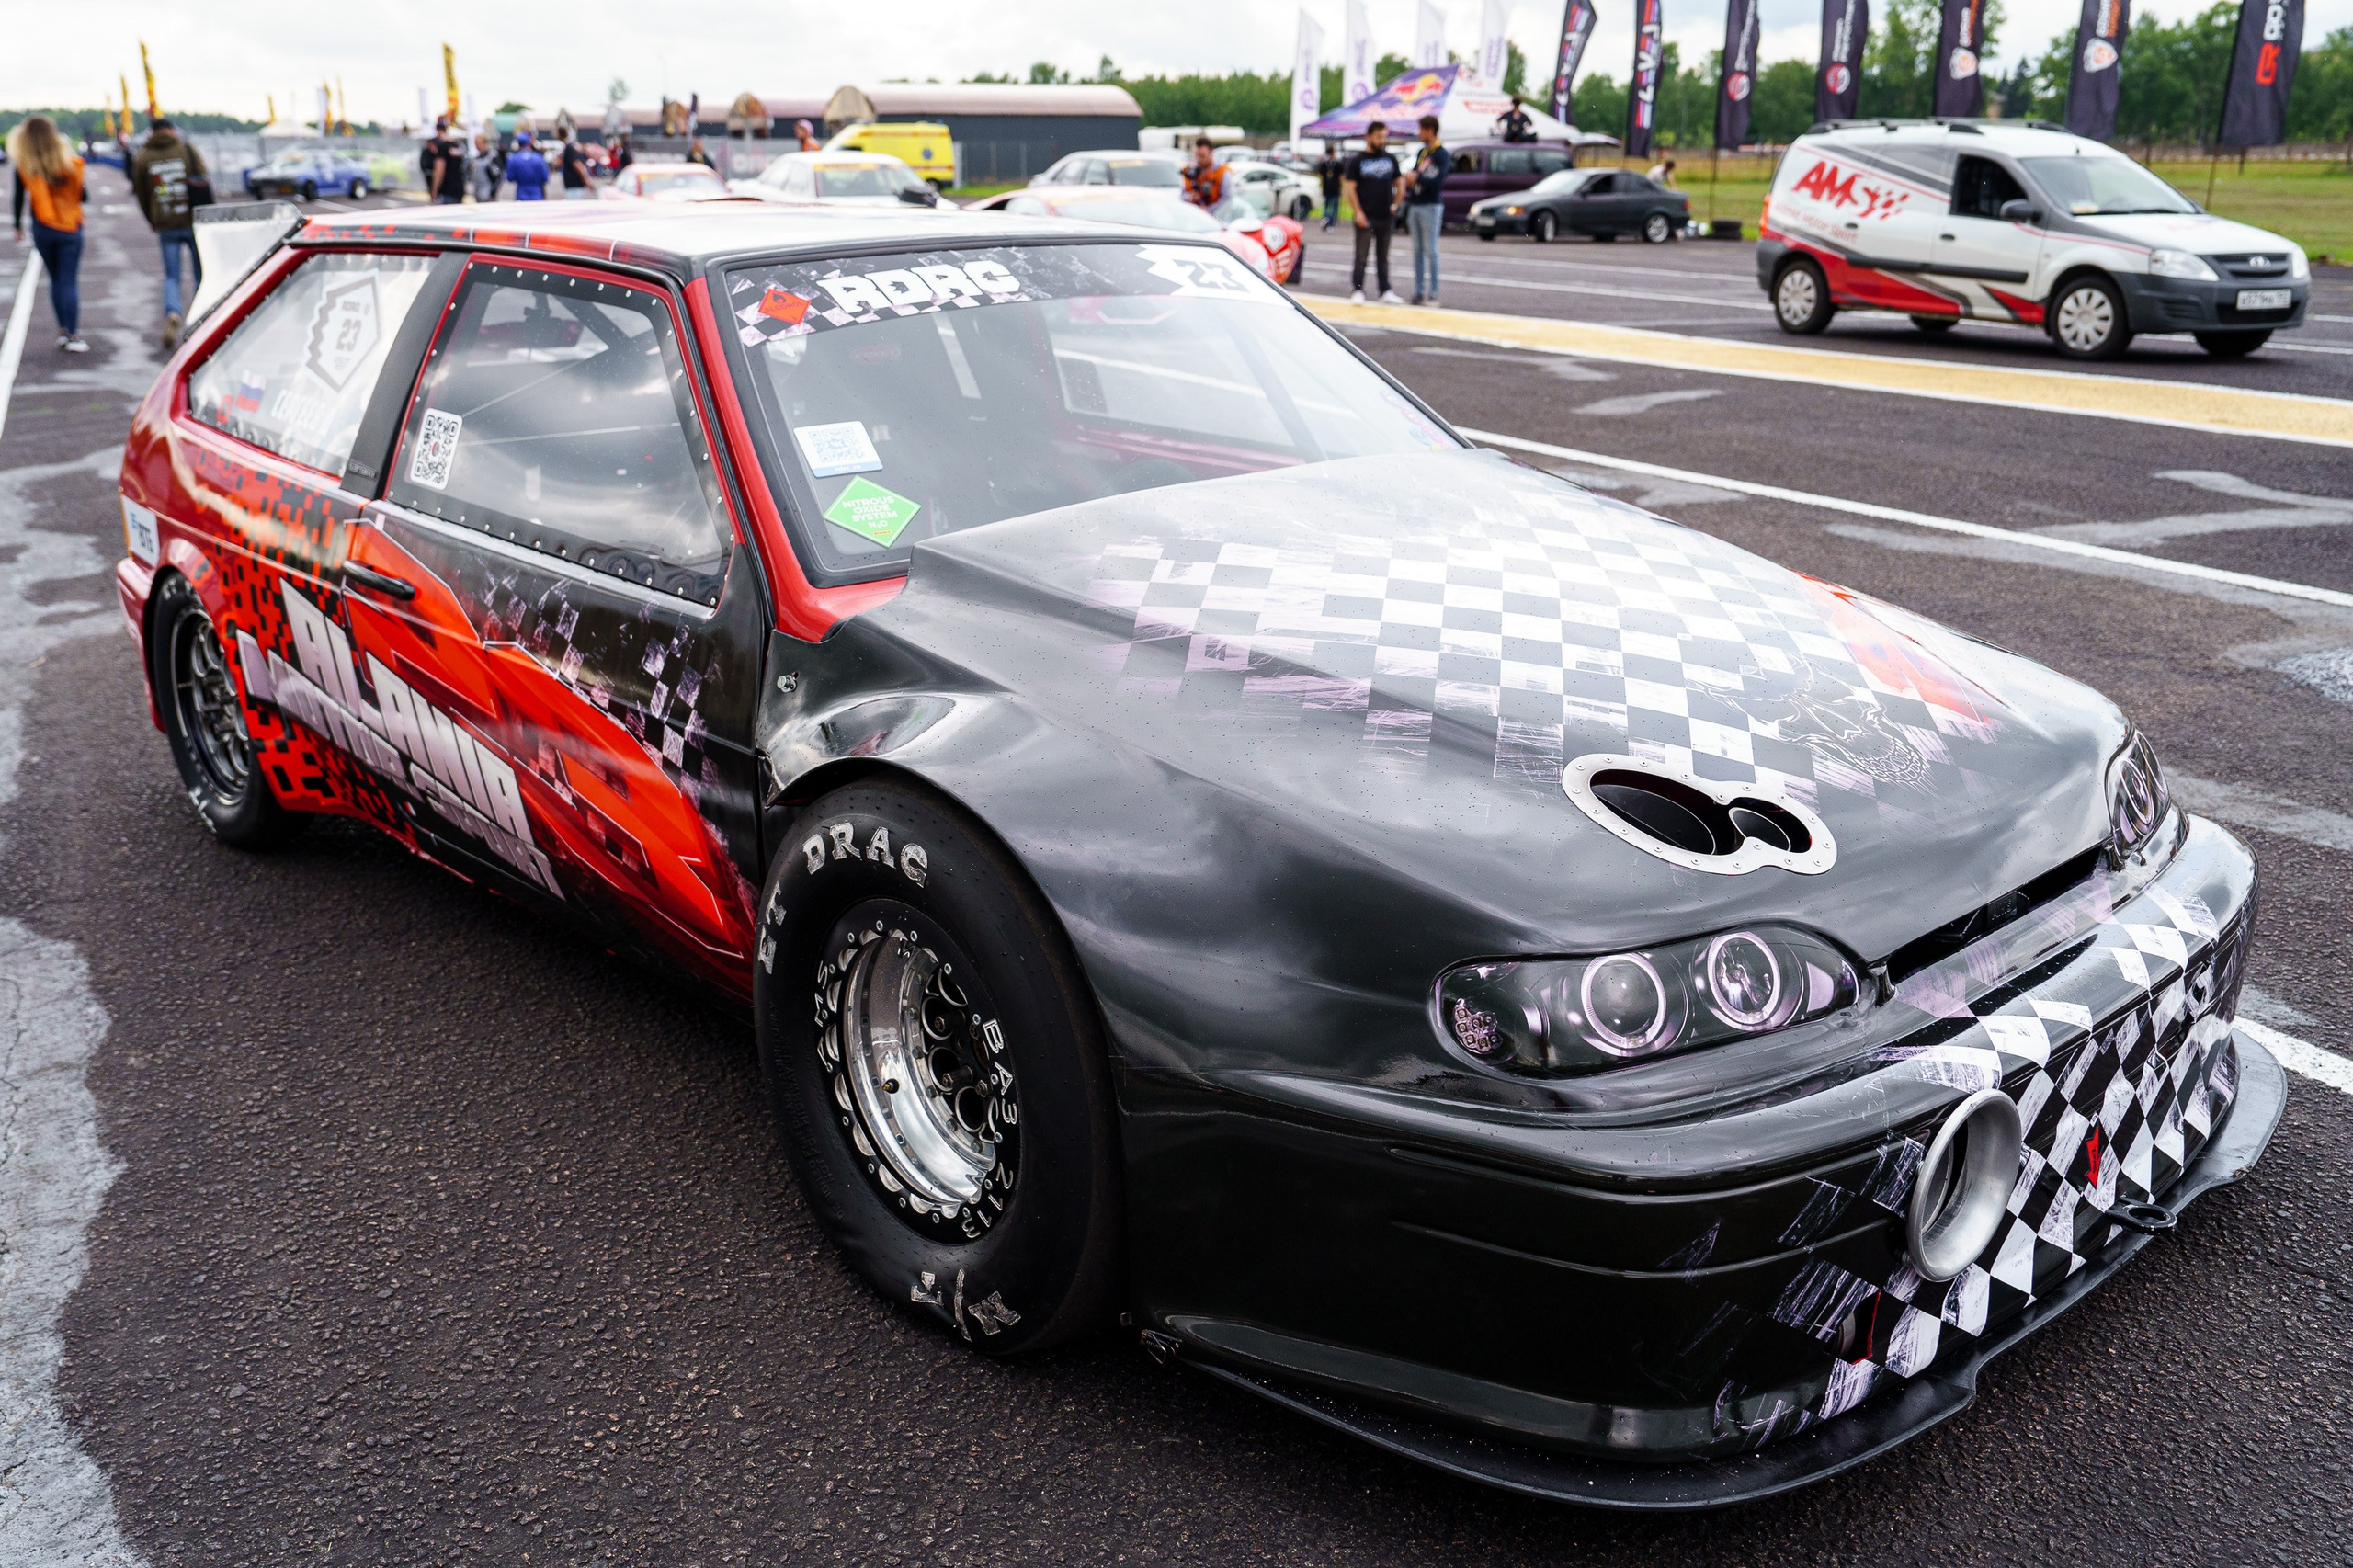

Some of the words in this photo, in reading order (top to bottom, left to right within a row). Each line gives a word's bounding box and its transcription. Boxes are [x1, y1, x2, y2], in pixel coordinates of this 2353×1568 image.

[817, 259, 1021, 313] RDRC
[1173, 259, 1250, 293] 23
[763, 299, 806, 314] ALCOHOL
[335, 318, 362, 352] 23
[841, 495, 895, 508] NITROUS
[850, 510, 899, 523] SYSTEM
[853, 503, 892, 515] OXIDE
[279, 576, 537, 846] ALANIA
[757, 881, 788, 975] ET
[801, 819, 929, 889] DRAG
[961, 1160, 1015, 1240] 2113
[910, 1268, 1022, 1343] M/T
